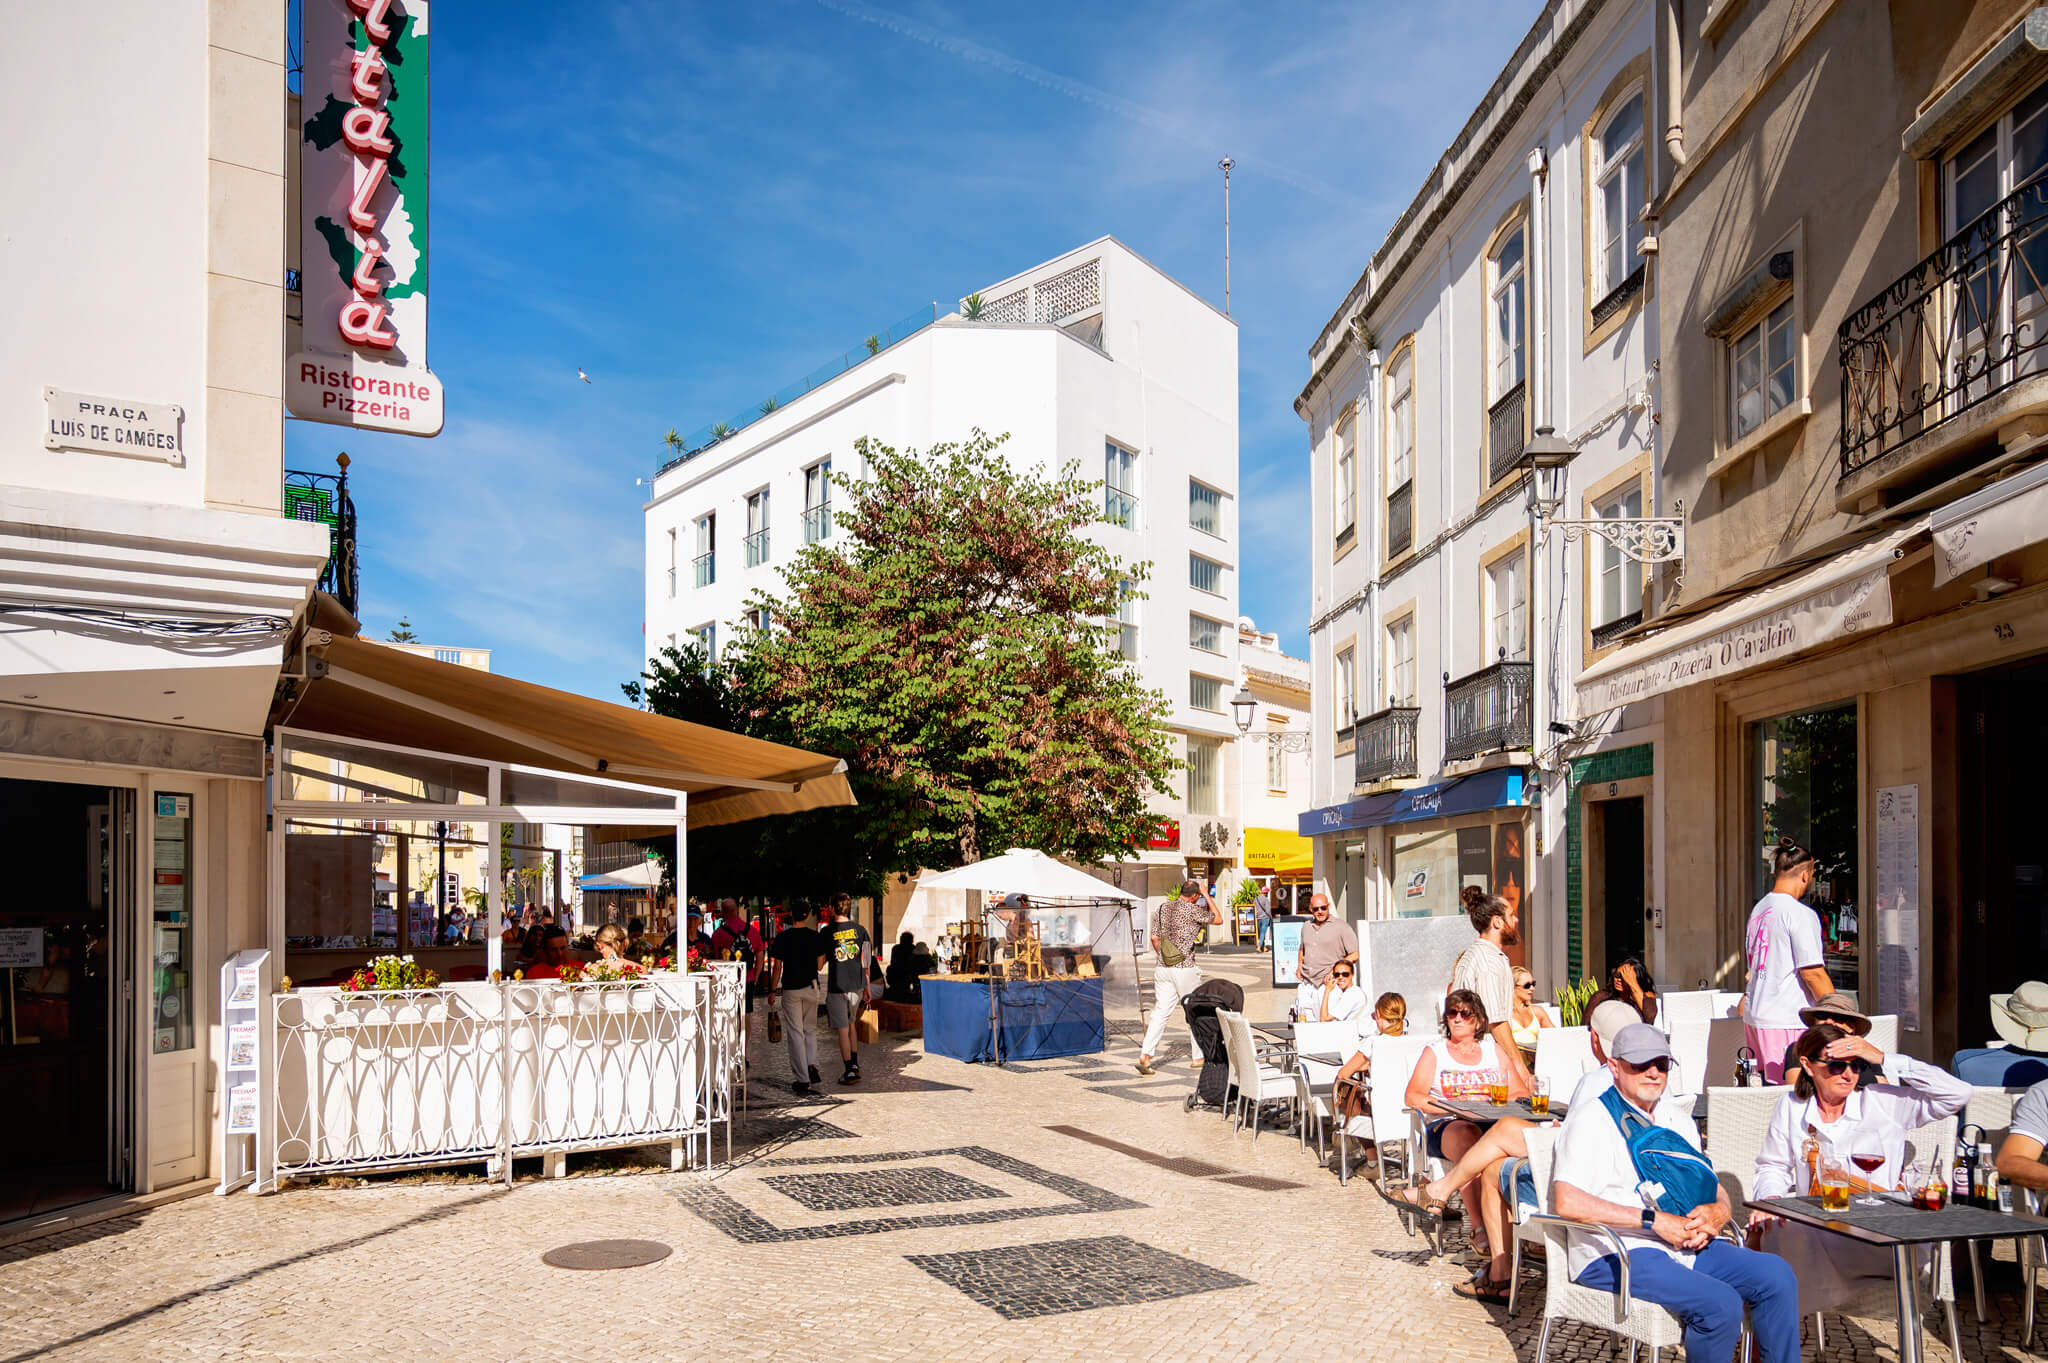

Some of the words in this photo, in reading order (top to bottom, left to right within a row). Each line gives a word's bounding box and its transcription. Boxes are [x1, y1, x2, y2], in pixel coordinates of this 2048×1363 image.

[300, 362, 431, 402] Ristorante
[79, 402, 148, 423] PRAÇA
[322, 390, 411, 421] Pizzeria
[91, 424, 110, 442] DE
[115, 428, 175, 450] CAMÕES
[1994, 623, 2015, 640] 23
[1668, 652, 1712, 682] Pizzeria
[1720, 642, 1732, 666] O
[1735, 622, 1797, 662] Cavaleiro
